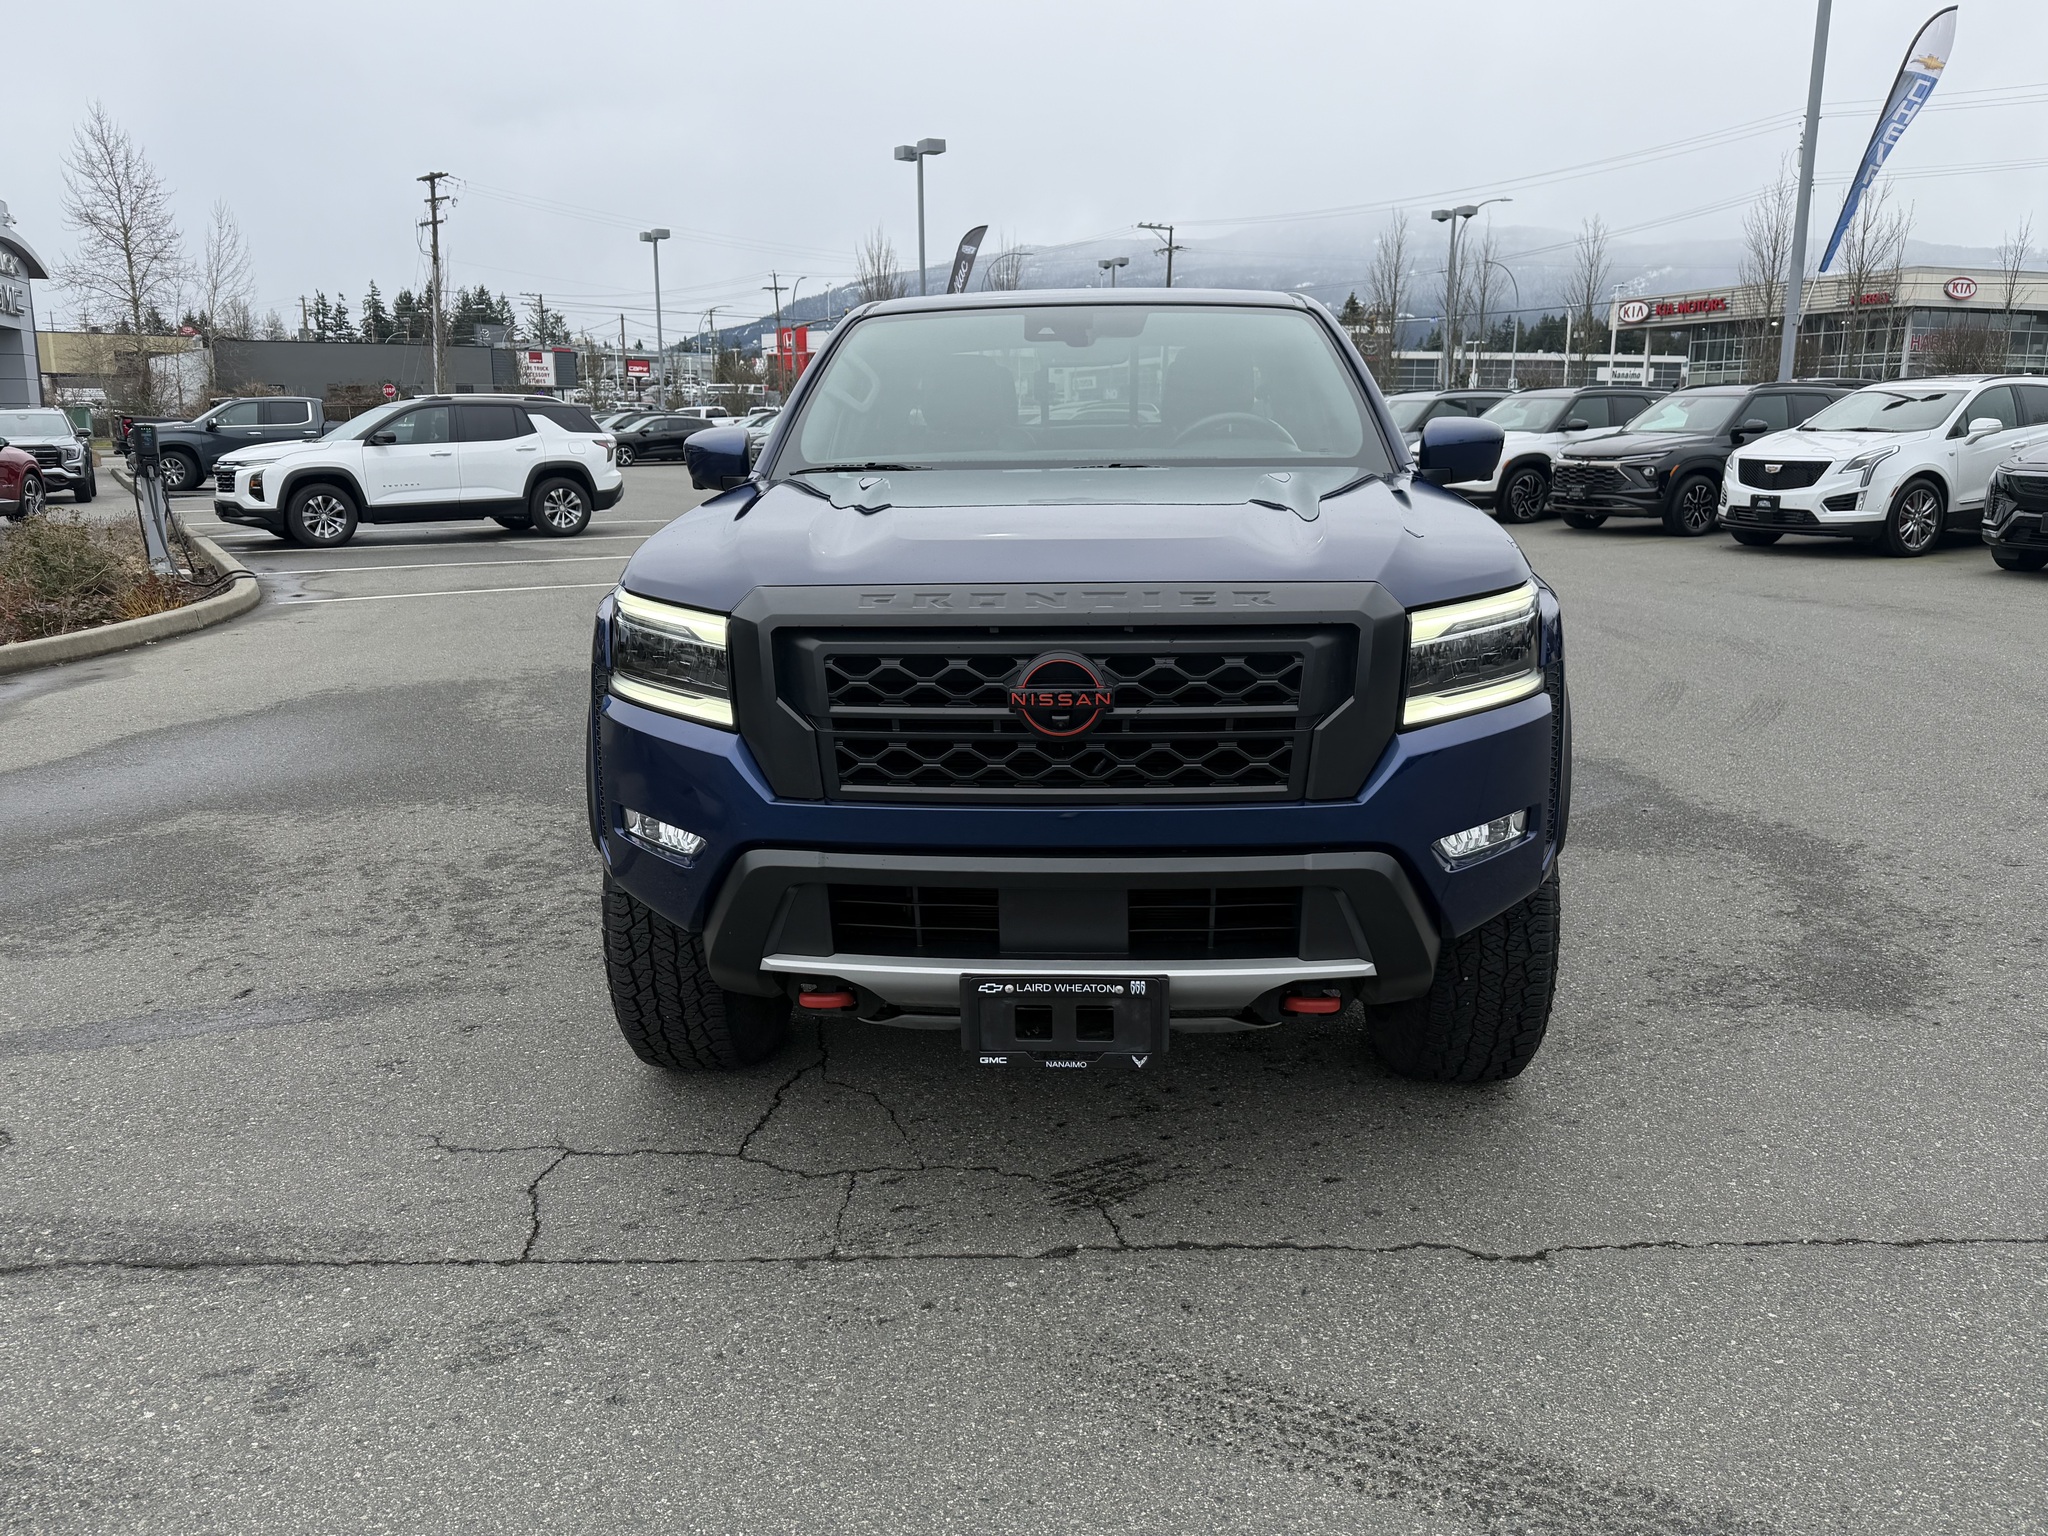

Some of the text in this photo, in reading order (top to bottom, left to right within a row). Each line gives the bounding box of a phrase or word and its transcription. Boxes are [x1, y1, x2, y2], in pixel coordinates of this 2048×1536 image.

[1952, 282, 1972, 294] KIA
[1623, 305, 1644, 318] KIA
[1655, 298, 1726, 316] KIA MOTORS
[1611, 370, 1641, 379] Nanaimo
[857, 590, 1277, 609] FRONTIER
[1011, 692, 1111, 707] NISSAN
[1016, 983, 1115, 993] LAIRD WHEATON
